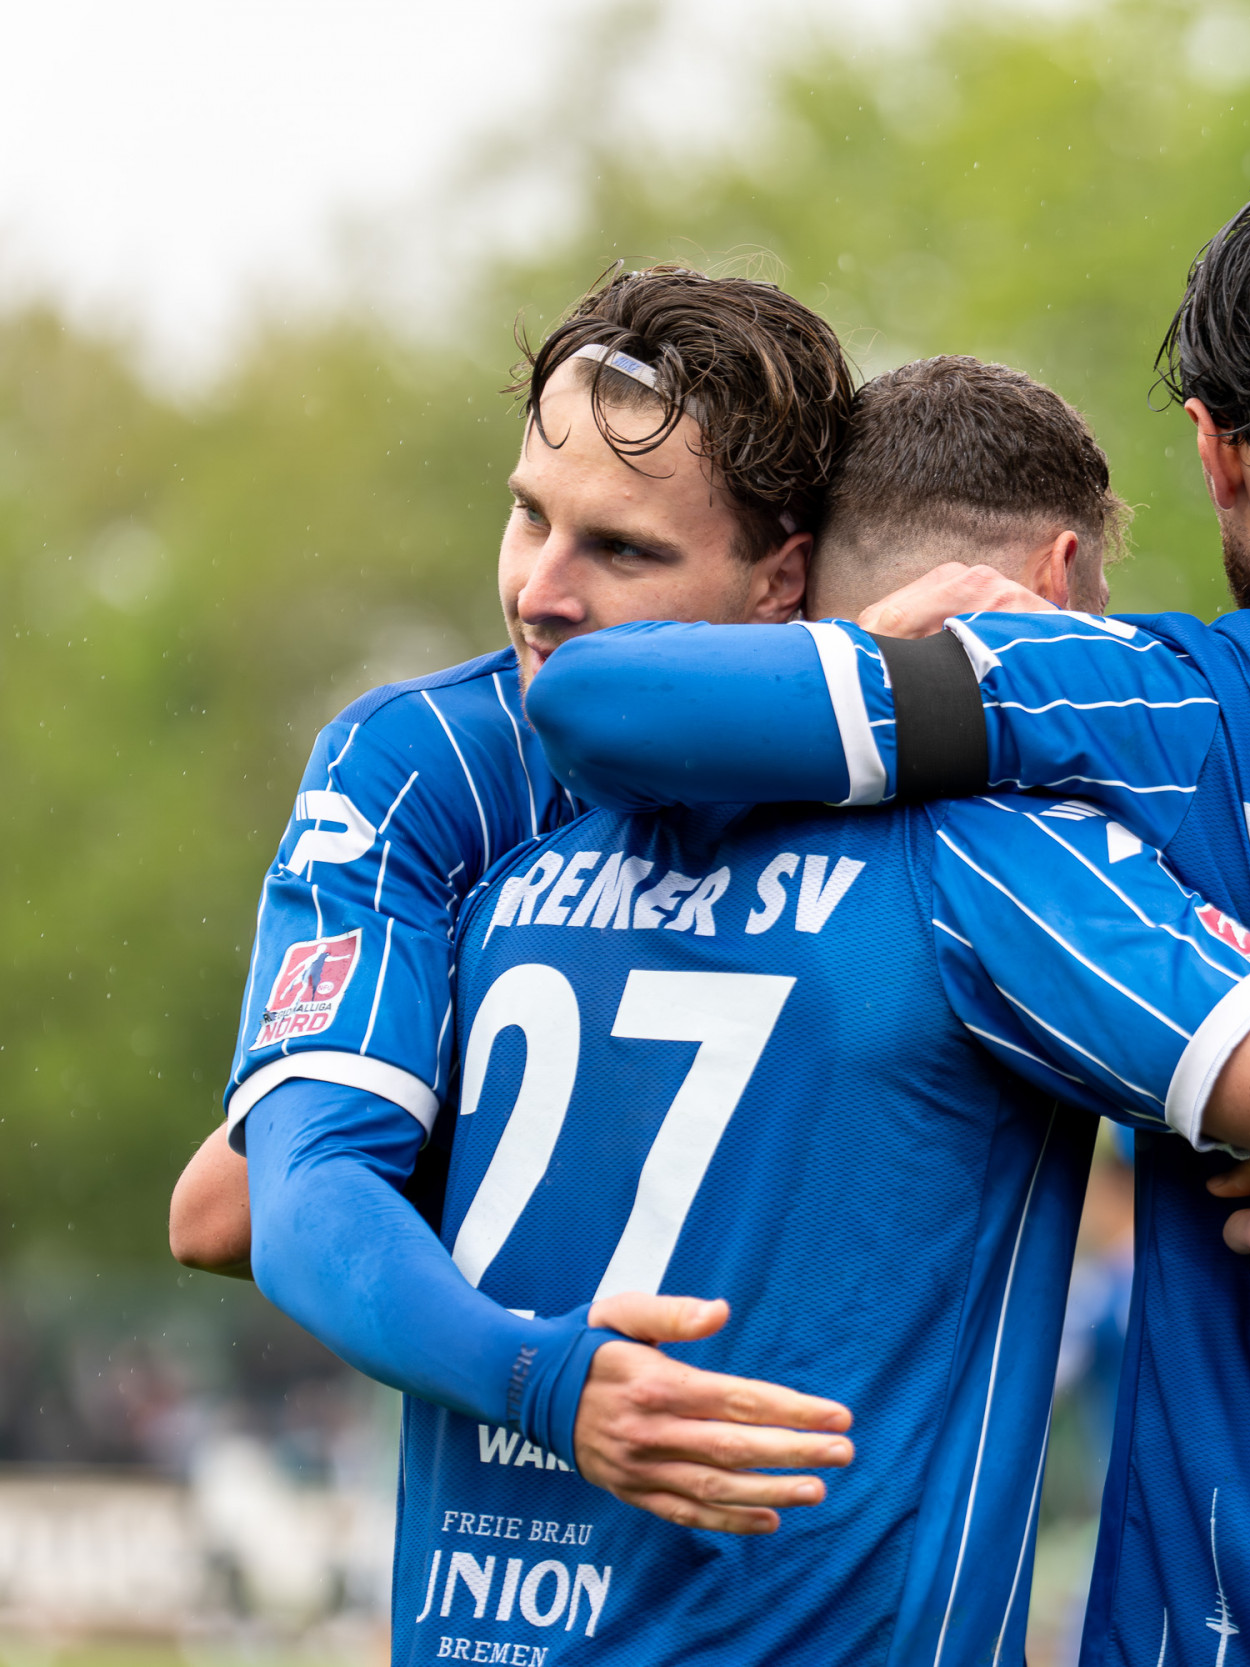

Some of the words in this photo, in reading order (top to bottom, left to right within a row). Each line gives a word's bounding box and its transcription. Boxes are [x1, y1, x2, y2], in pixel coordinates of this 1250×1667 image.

[745, 852, 866, 935] SV
[259, 1012, 330, 1045] NORD
[451, 963, 797, 1320] 27
[441, 1510, 522, 1540] FREIE
[528, 1520, 593, 1546] BRAU
[437, 1636, 549, 1667] BREMEN
